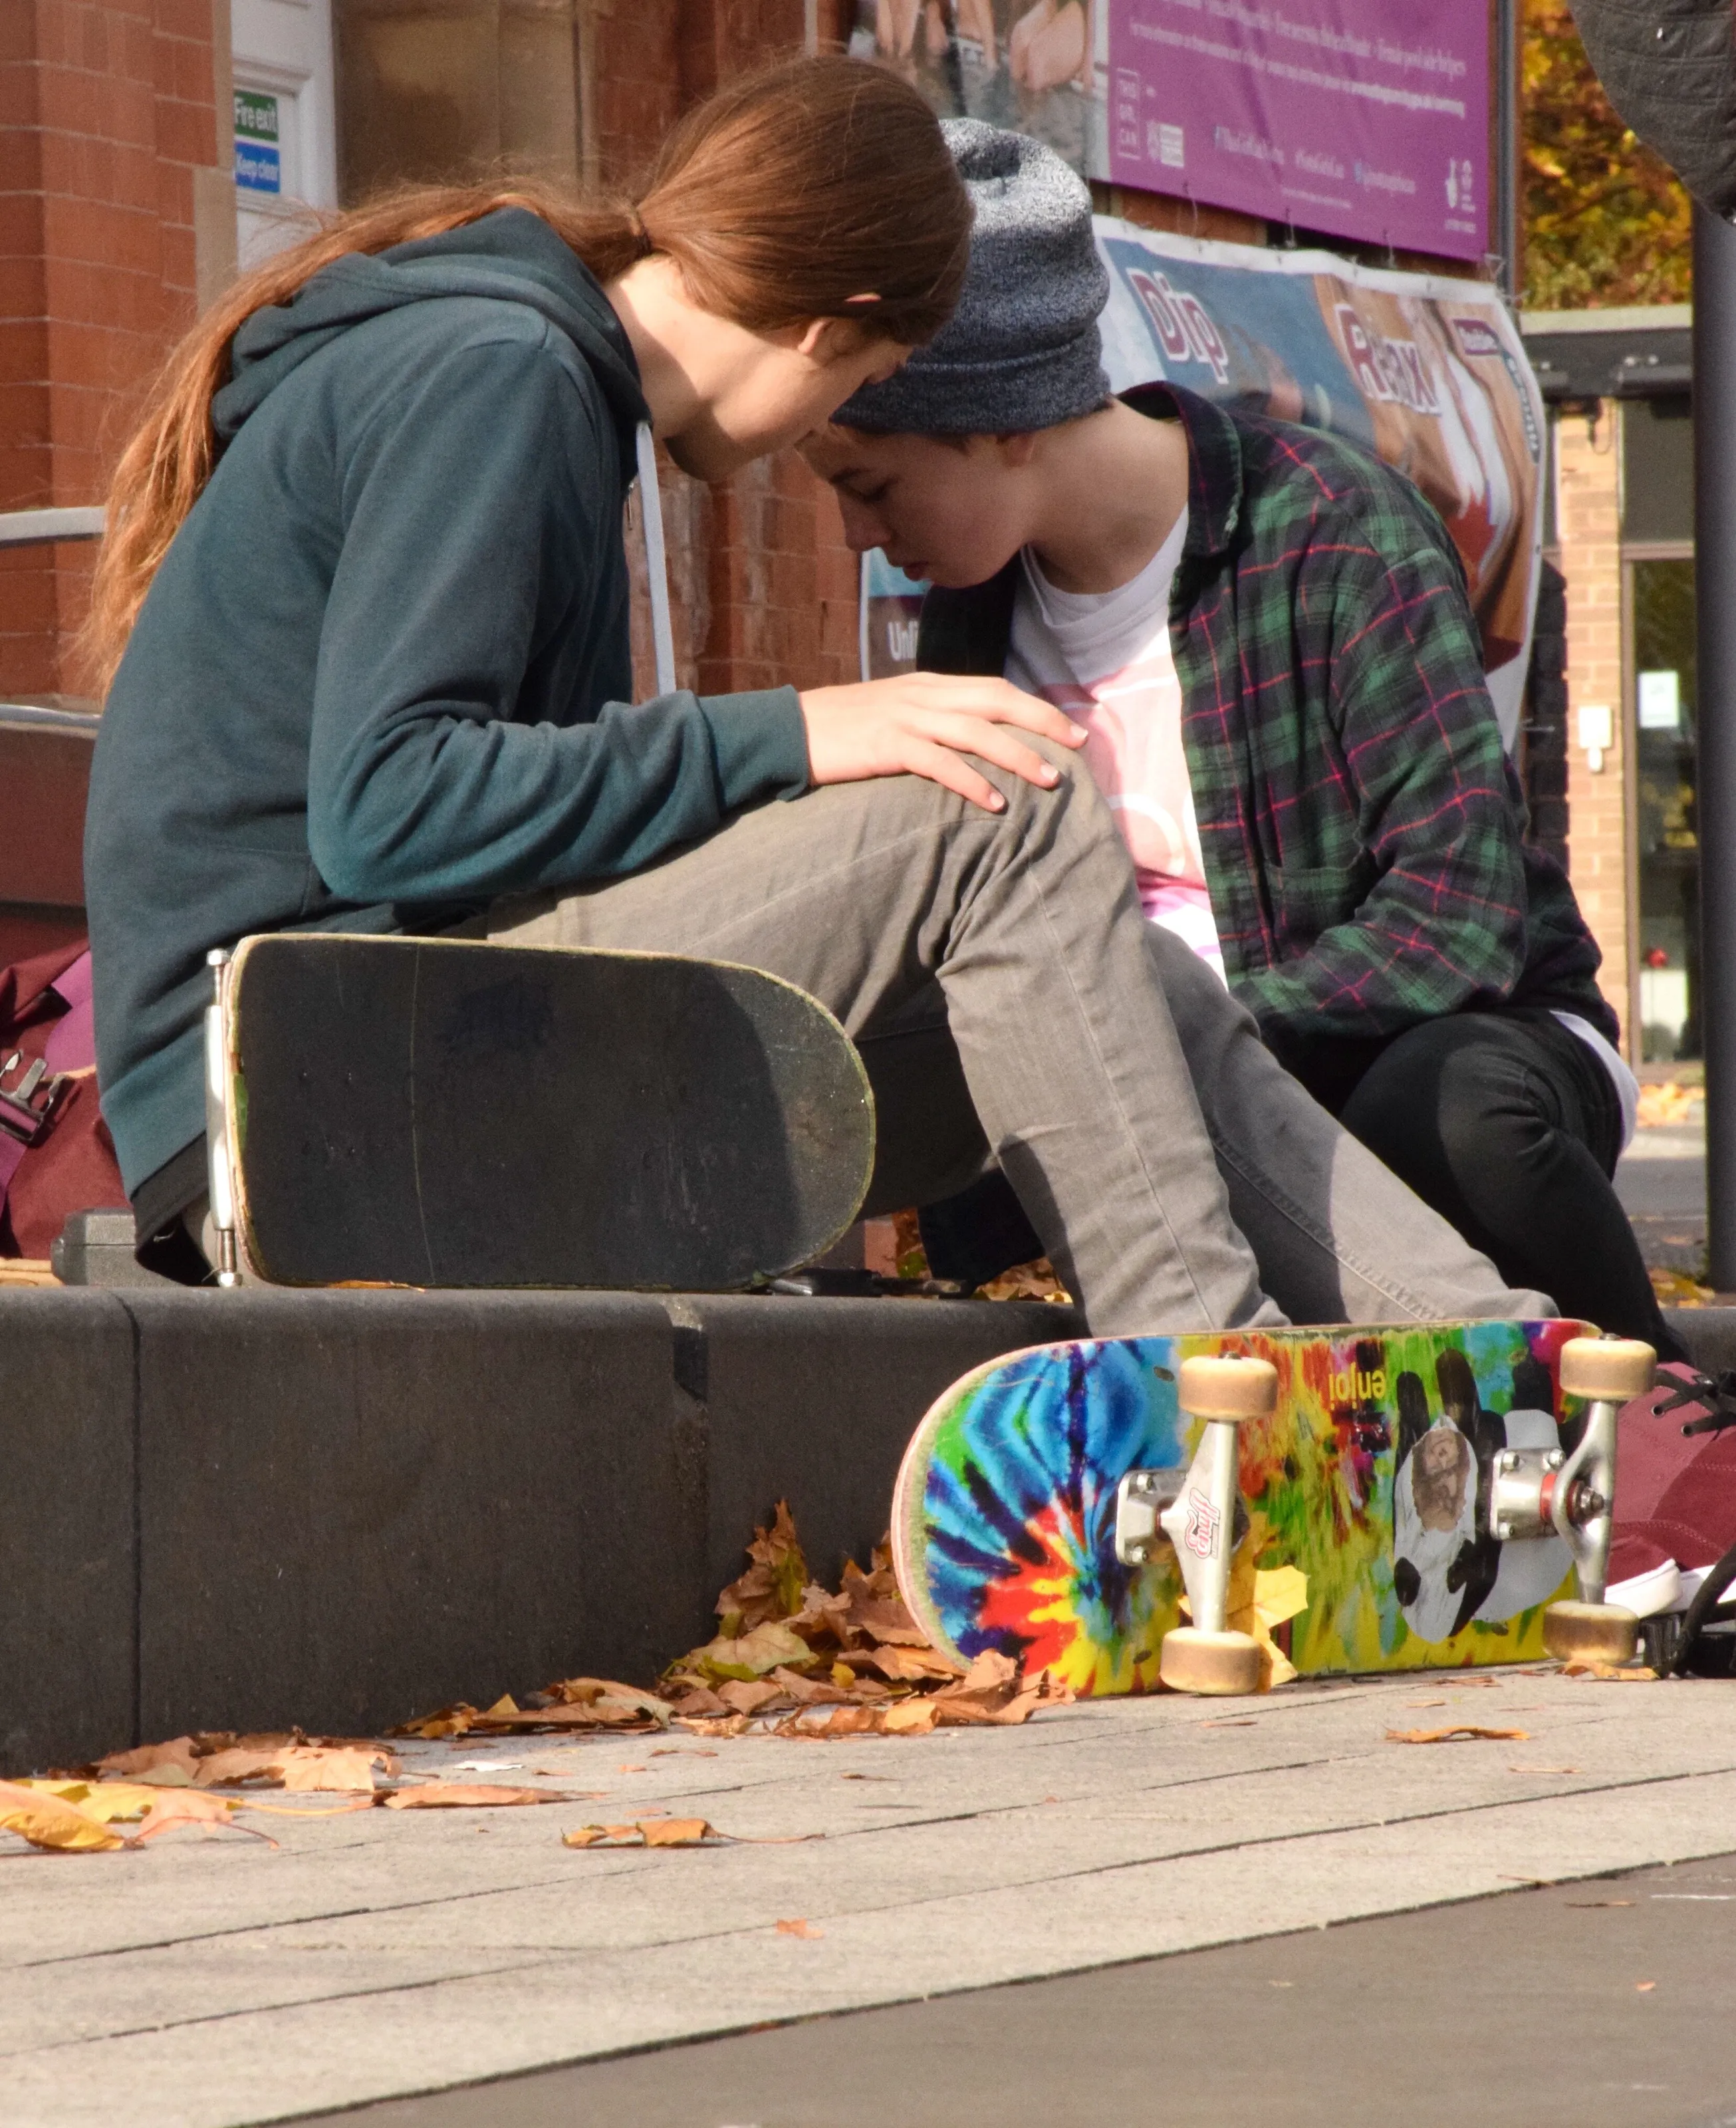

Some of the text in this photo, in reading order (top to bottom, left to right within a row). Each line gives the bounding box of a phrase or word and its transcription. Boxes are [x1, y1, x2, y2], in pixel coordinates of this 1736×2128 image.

[234, 97, 277, 132] Fire exit
[1126, 267, 1229, 384] Dip
[1328, 1361, 1386, 1410] enjoi
[1185, 1487, 1220, 1558] Enuff
